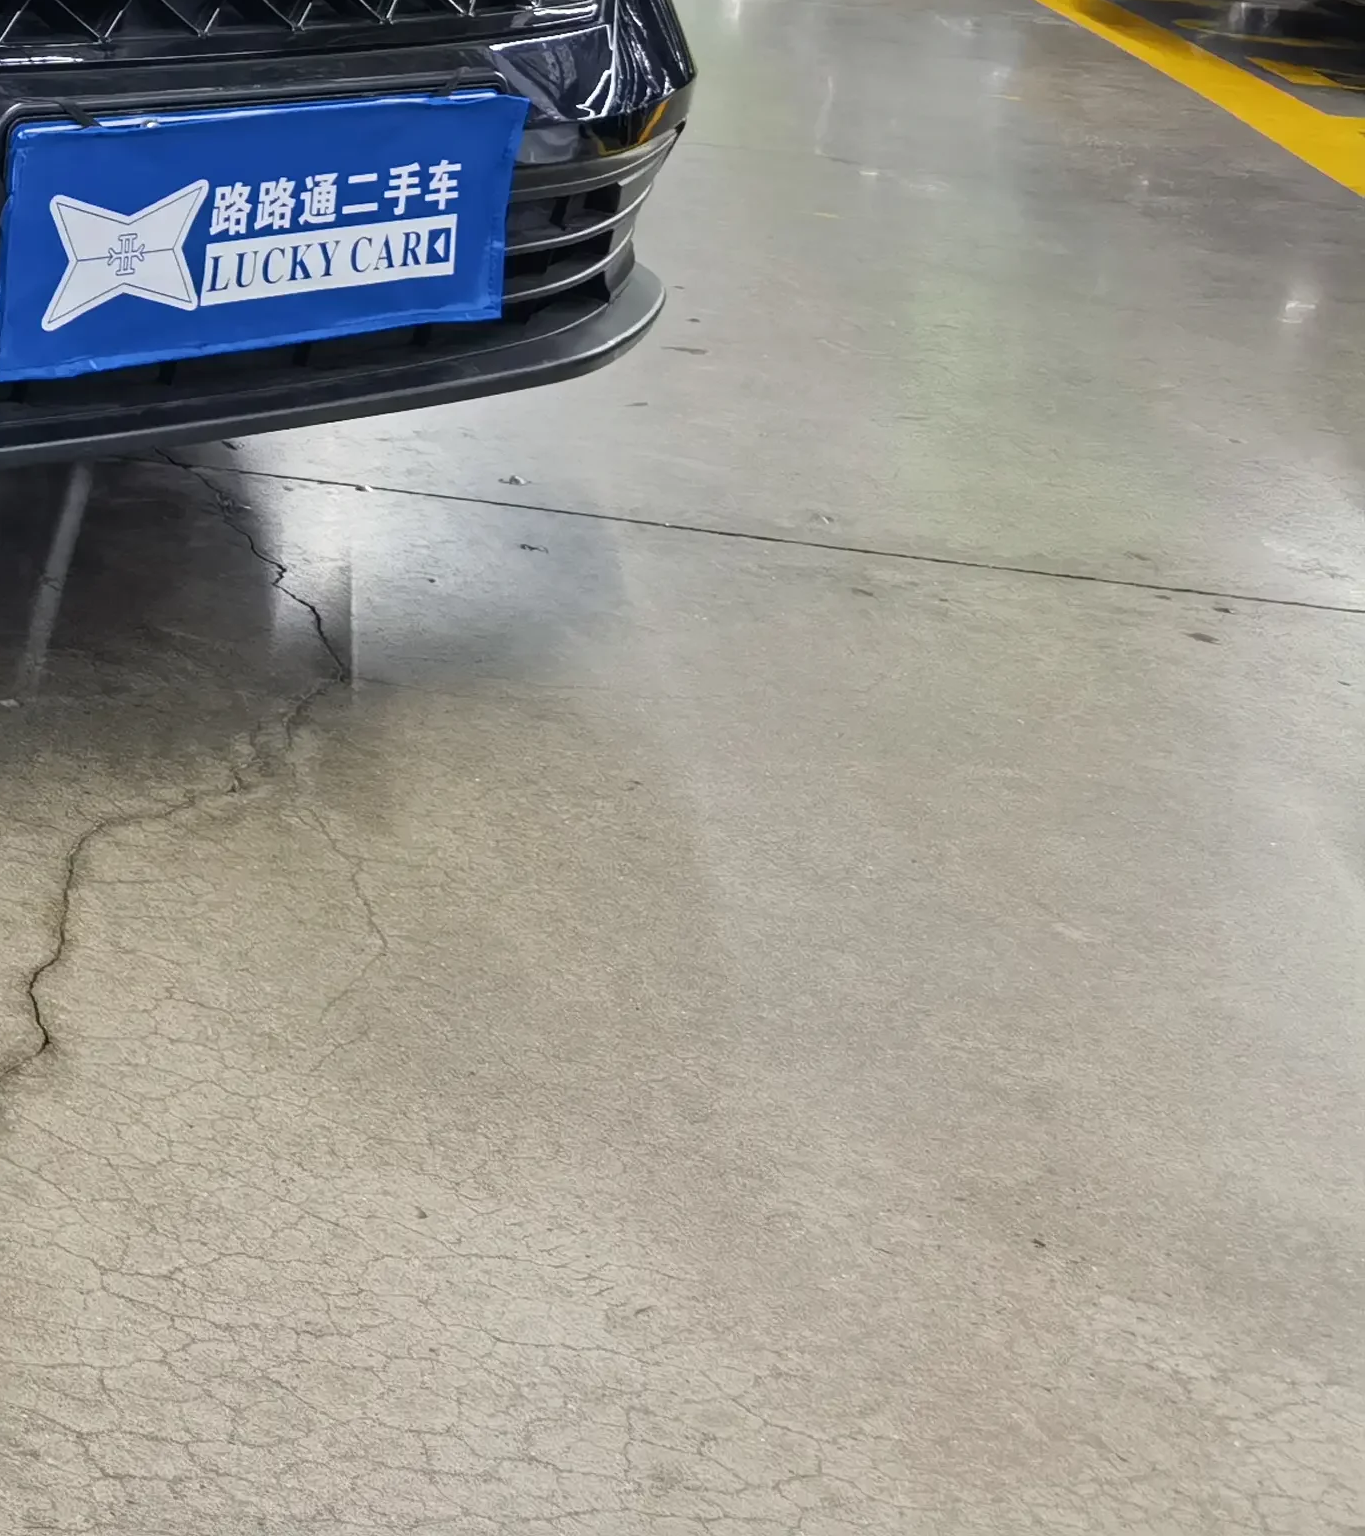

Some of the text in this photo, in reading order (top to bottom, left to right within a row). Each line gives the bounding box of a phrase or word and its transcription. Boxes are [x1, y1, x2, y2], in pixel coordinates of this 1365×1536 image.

[209, 159, 462, 236] 路路通二手车
[205, 230, 423, 293] LUCKY CAR
